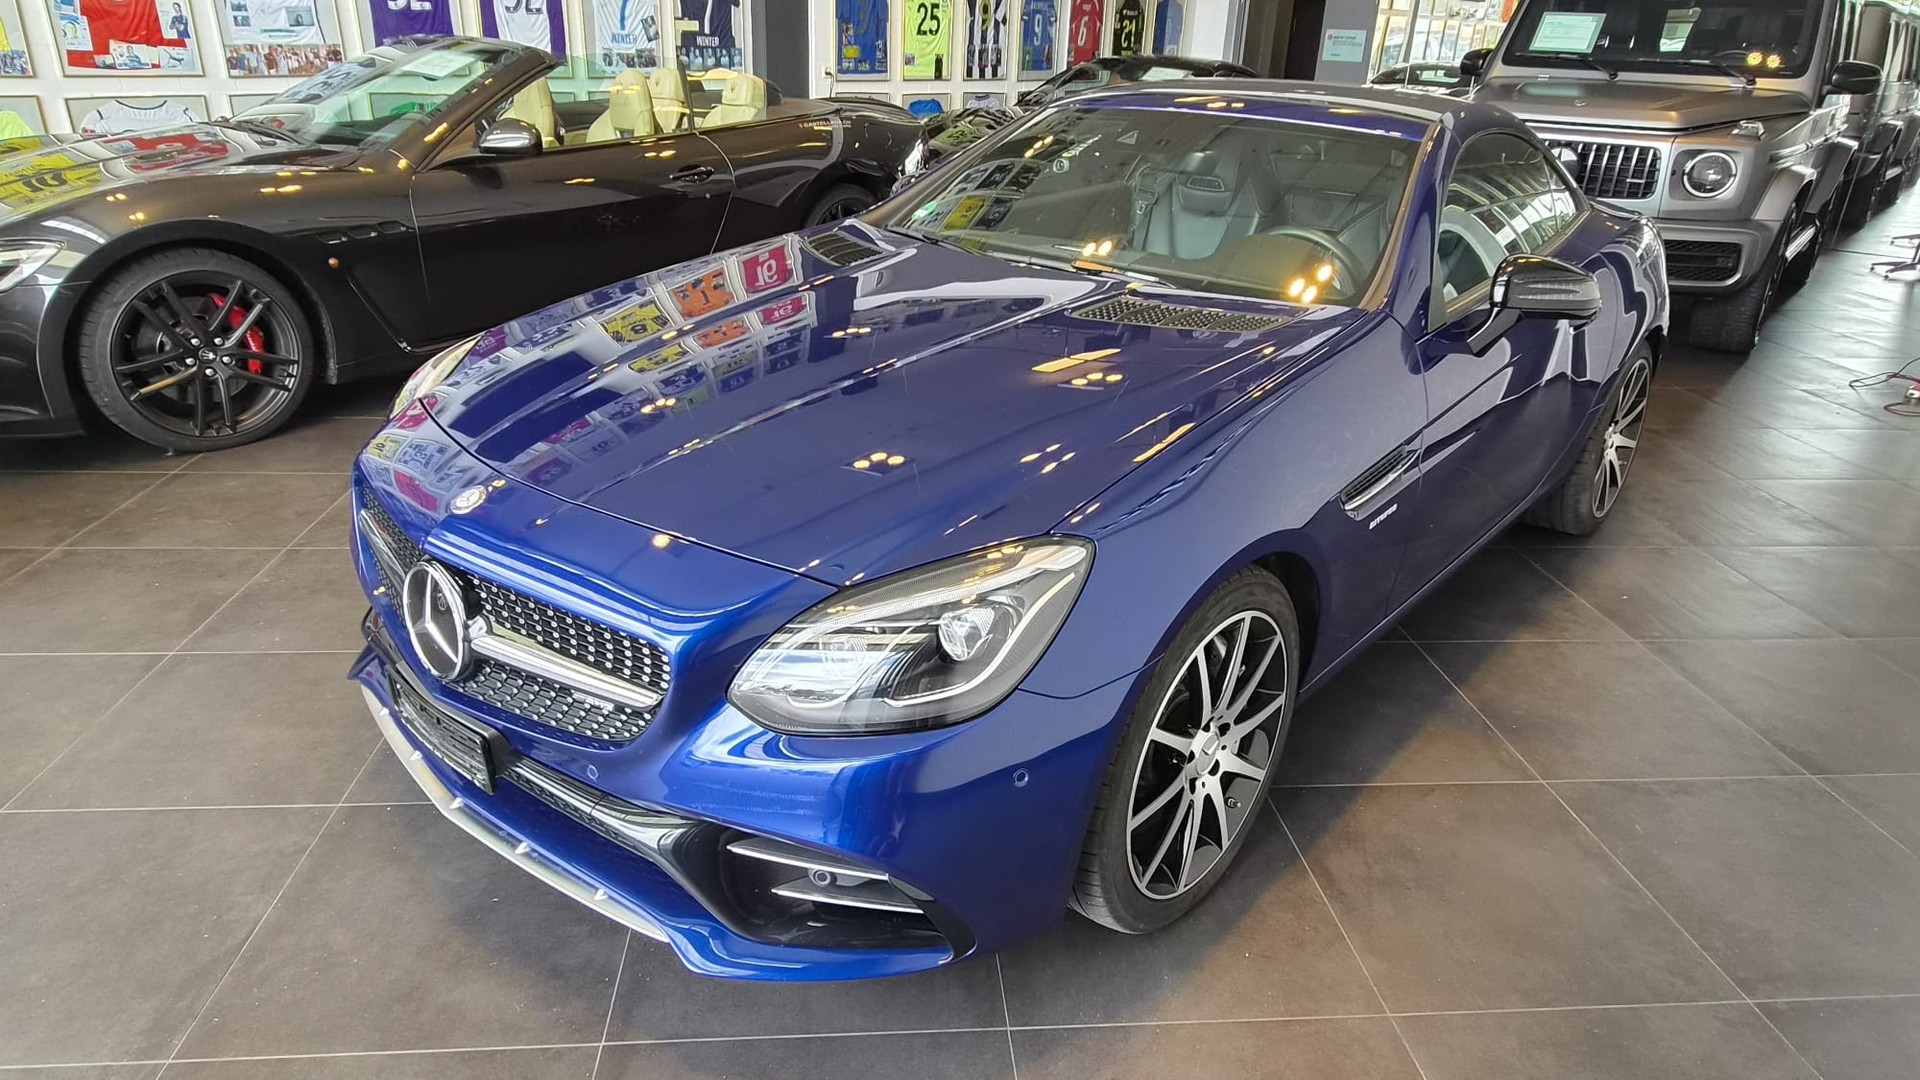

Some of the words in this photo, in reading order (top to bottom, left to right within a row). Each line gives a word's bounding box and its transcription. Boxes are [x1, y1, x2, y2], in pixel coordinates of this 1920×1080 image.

[916, 2, 941, 36] 25
[1033, 13, 1043, 46] 9
[1077, 15, 1089, 46] 6
[1121, 19, 1136, 48] 21
[610, 32, 637, 45] WINTER
[696, 35, 719, 47] WINTER
